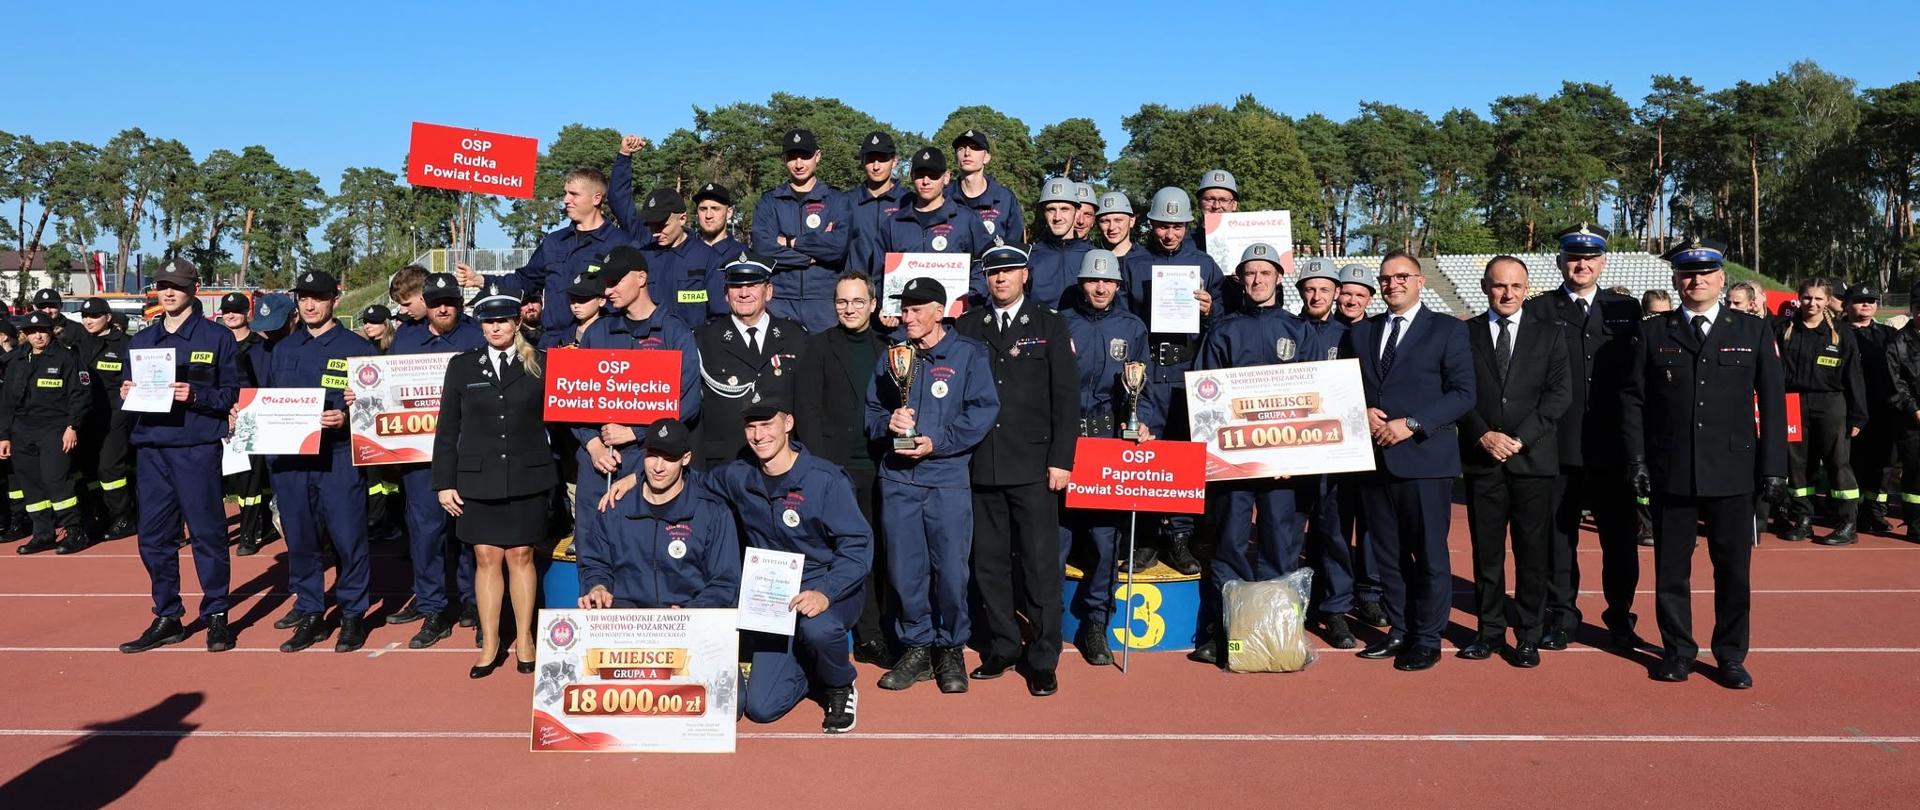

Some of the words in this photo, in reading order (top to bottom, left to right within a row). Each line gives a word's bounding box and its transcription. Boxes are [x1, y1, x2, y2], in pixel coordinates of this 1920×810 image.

[461, 138, 492, 152] OSP
[453, 152, 497, 169] Rudka
[423, 164, 470, 180] Powiat
[473, 170, 523, 187] Łosicki
[329, 360, 346, 369] OSP
[597, 360, 630, 374] OSP
[400, 387, 409, 397] II
[413, 385, 443, 397] MIEJ
[556, 377, 601, 394] Rytele
[605, 375, 671, 395] Święckie
[548, 395, 594, 409] Powiat
[598, 397, 678, 411] Sokołowski
[1239, 400, 1254, 410] III
[1257, 395, 1313, 408] MIEJSCE
[1257, 412, 1287, 420] GRUPA
[379, 416, 403, 434] 14
[1222, 429, 1247, 448] 11
[1251, 425, 1323, 445] 000,00
[1326, 427, 1339, 441] zł
[1122, 450, 1156, 464] OSP
[1102, 467, 1174, 482] Paprotnia
[1067, 482, 1112, 496] Powiat
[656, 614, 691, 622] ZAWODY
[1112, 583, 1166, 649] 3
[599, 651, 604, 664] I
[609, 651, 674, 664] MIEJSCE
[613, 669, 645, 678] GRUPA
[649, 669, 657, 678] A
[568, 688, 597, 712] 18
[602, 688, 683, 714] 000,00
[686, 696, 702, 712] zł
